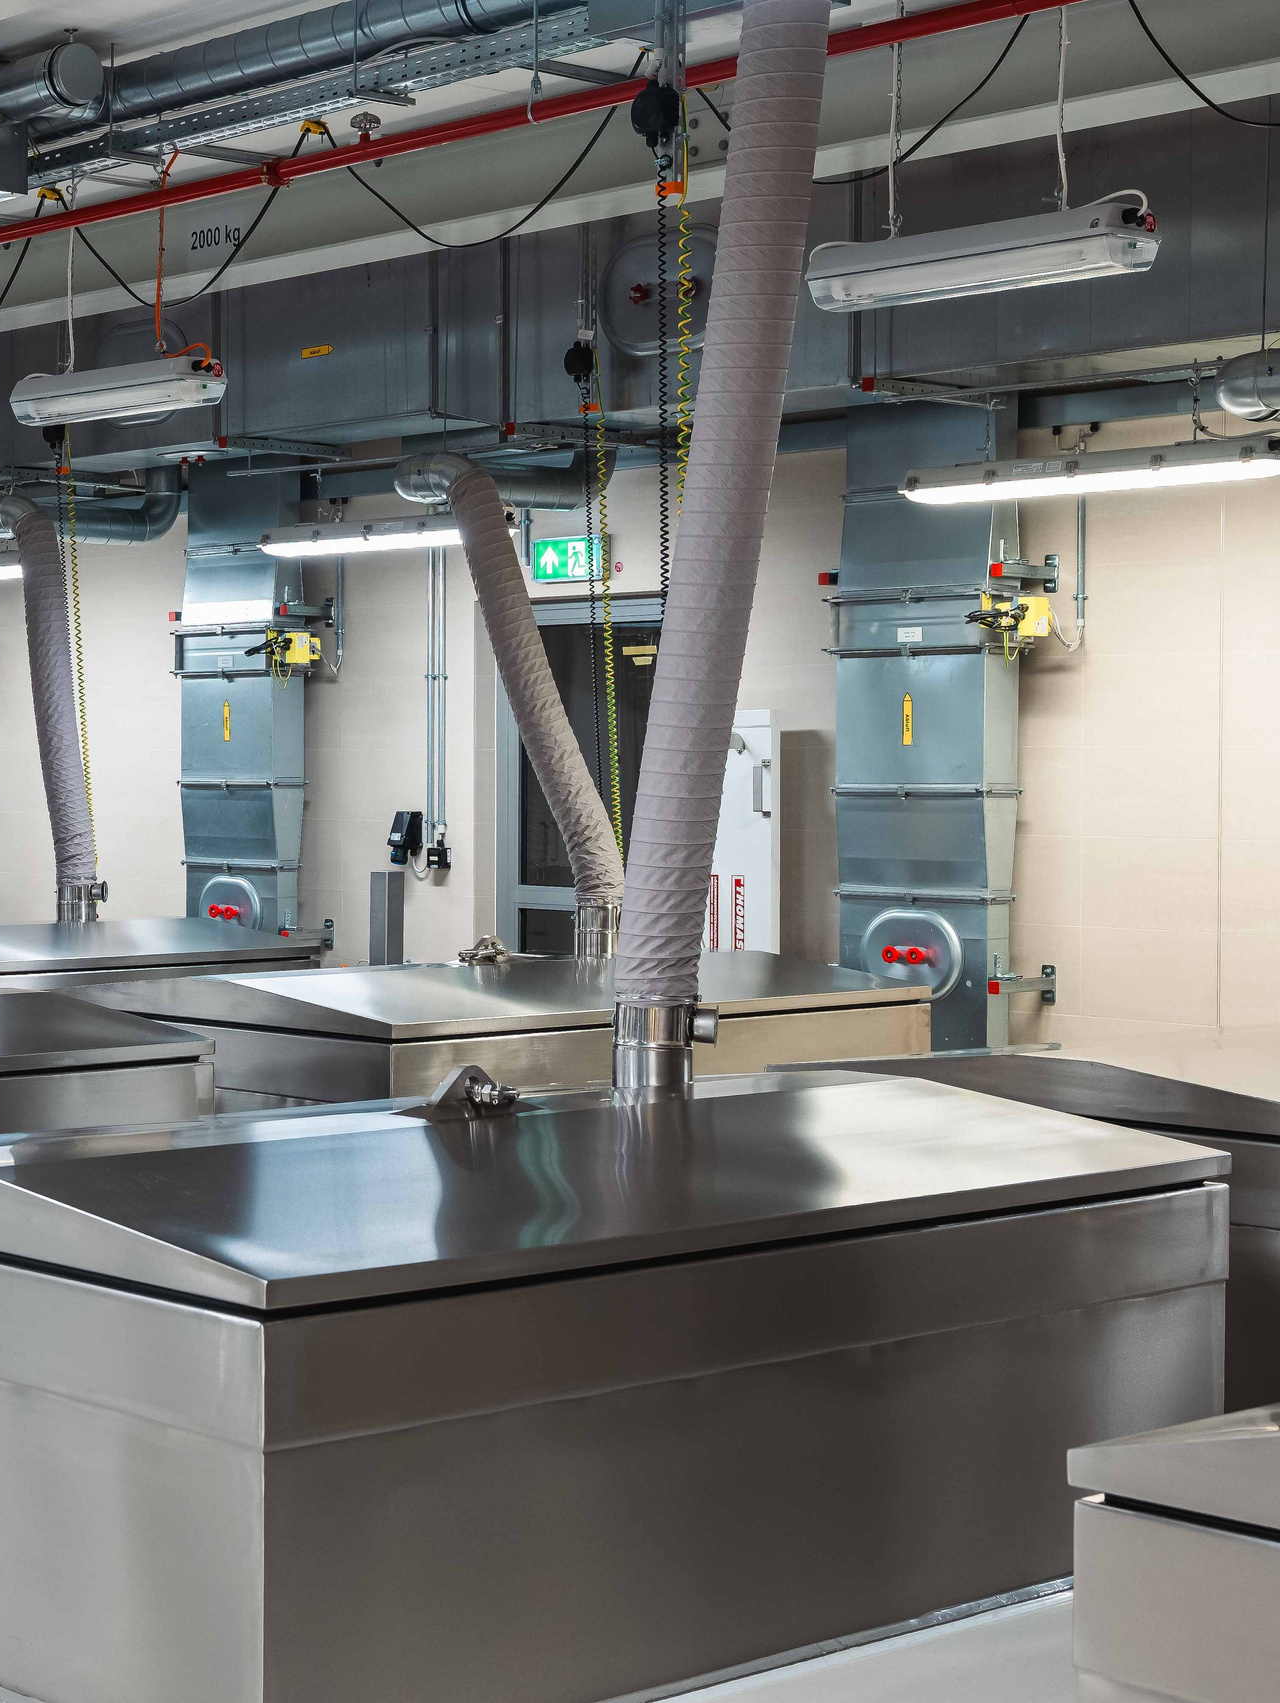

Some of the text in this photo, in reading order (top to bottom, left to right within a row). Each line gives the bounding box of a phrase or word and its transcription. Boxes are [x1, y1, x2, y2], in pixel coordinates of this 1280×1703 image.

[191, 224, 241, 251] 2000 kg
[735, 885, 744, 949] THOMAS
